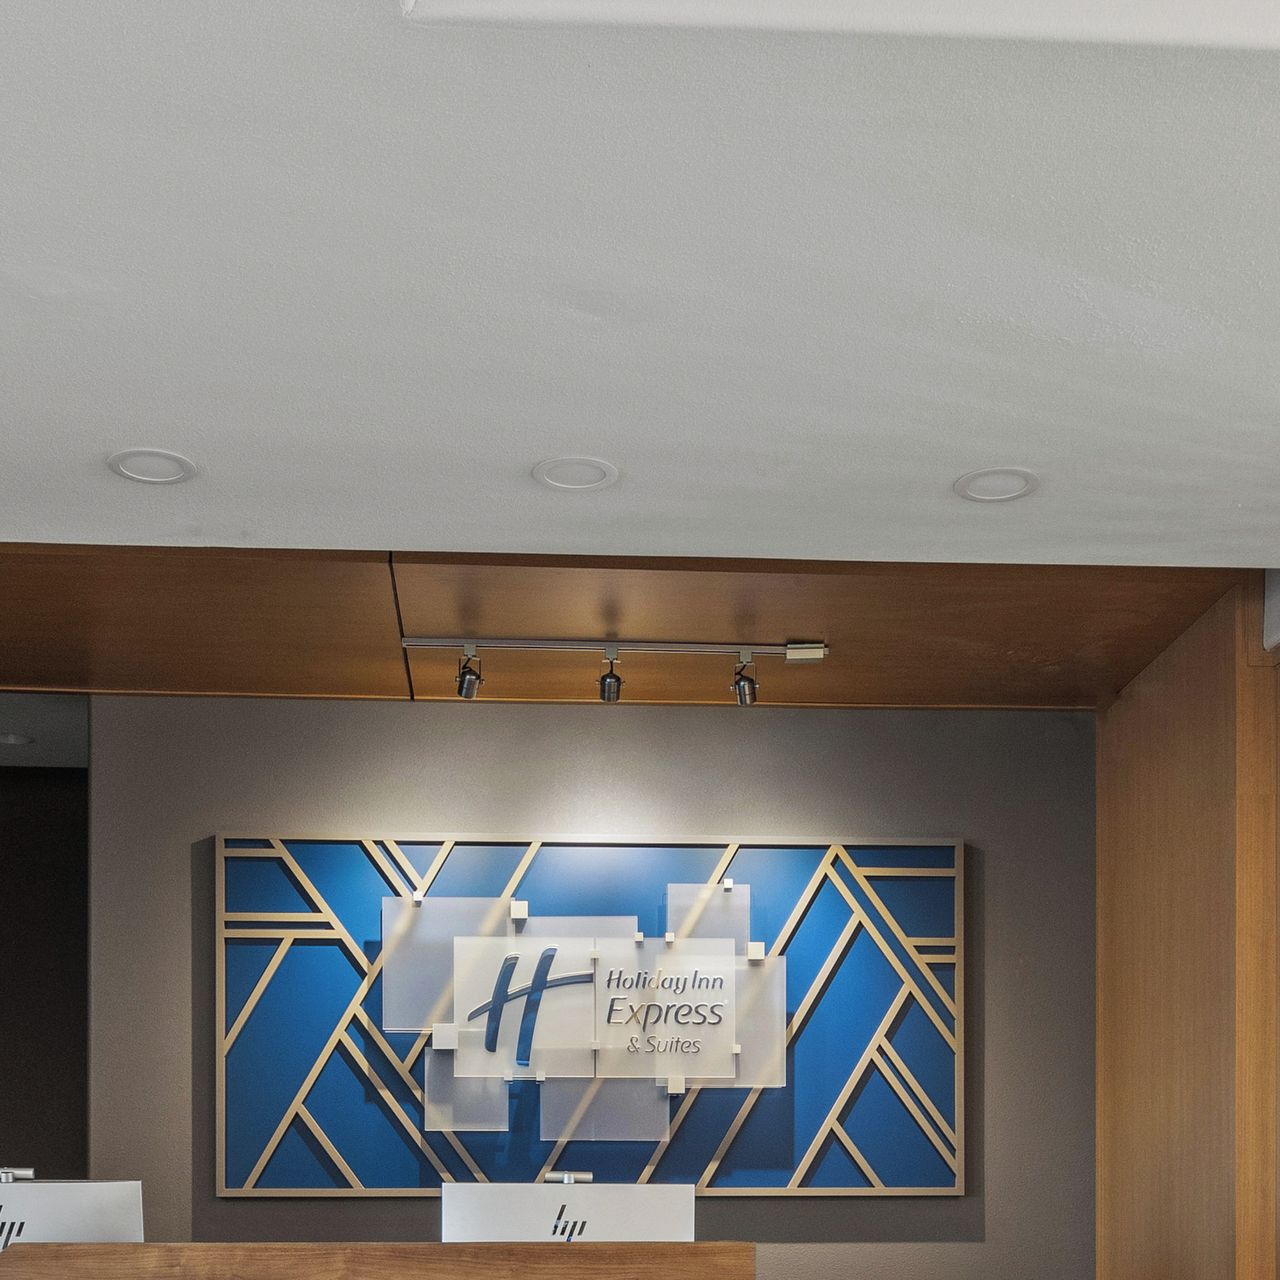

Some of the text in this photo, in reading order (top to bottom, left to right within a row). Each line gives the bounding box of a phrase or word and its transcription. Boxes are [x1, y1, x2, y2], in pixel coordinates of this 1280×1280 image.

[606, 968, 724, 995] Holiday Inn
[606, 995, 724, 1032] Express
[626, 1035, 702, 1054] & Suites
